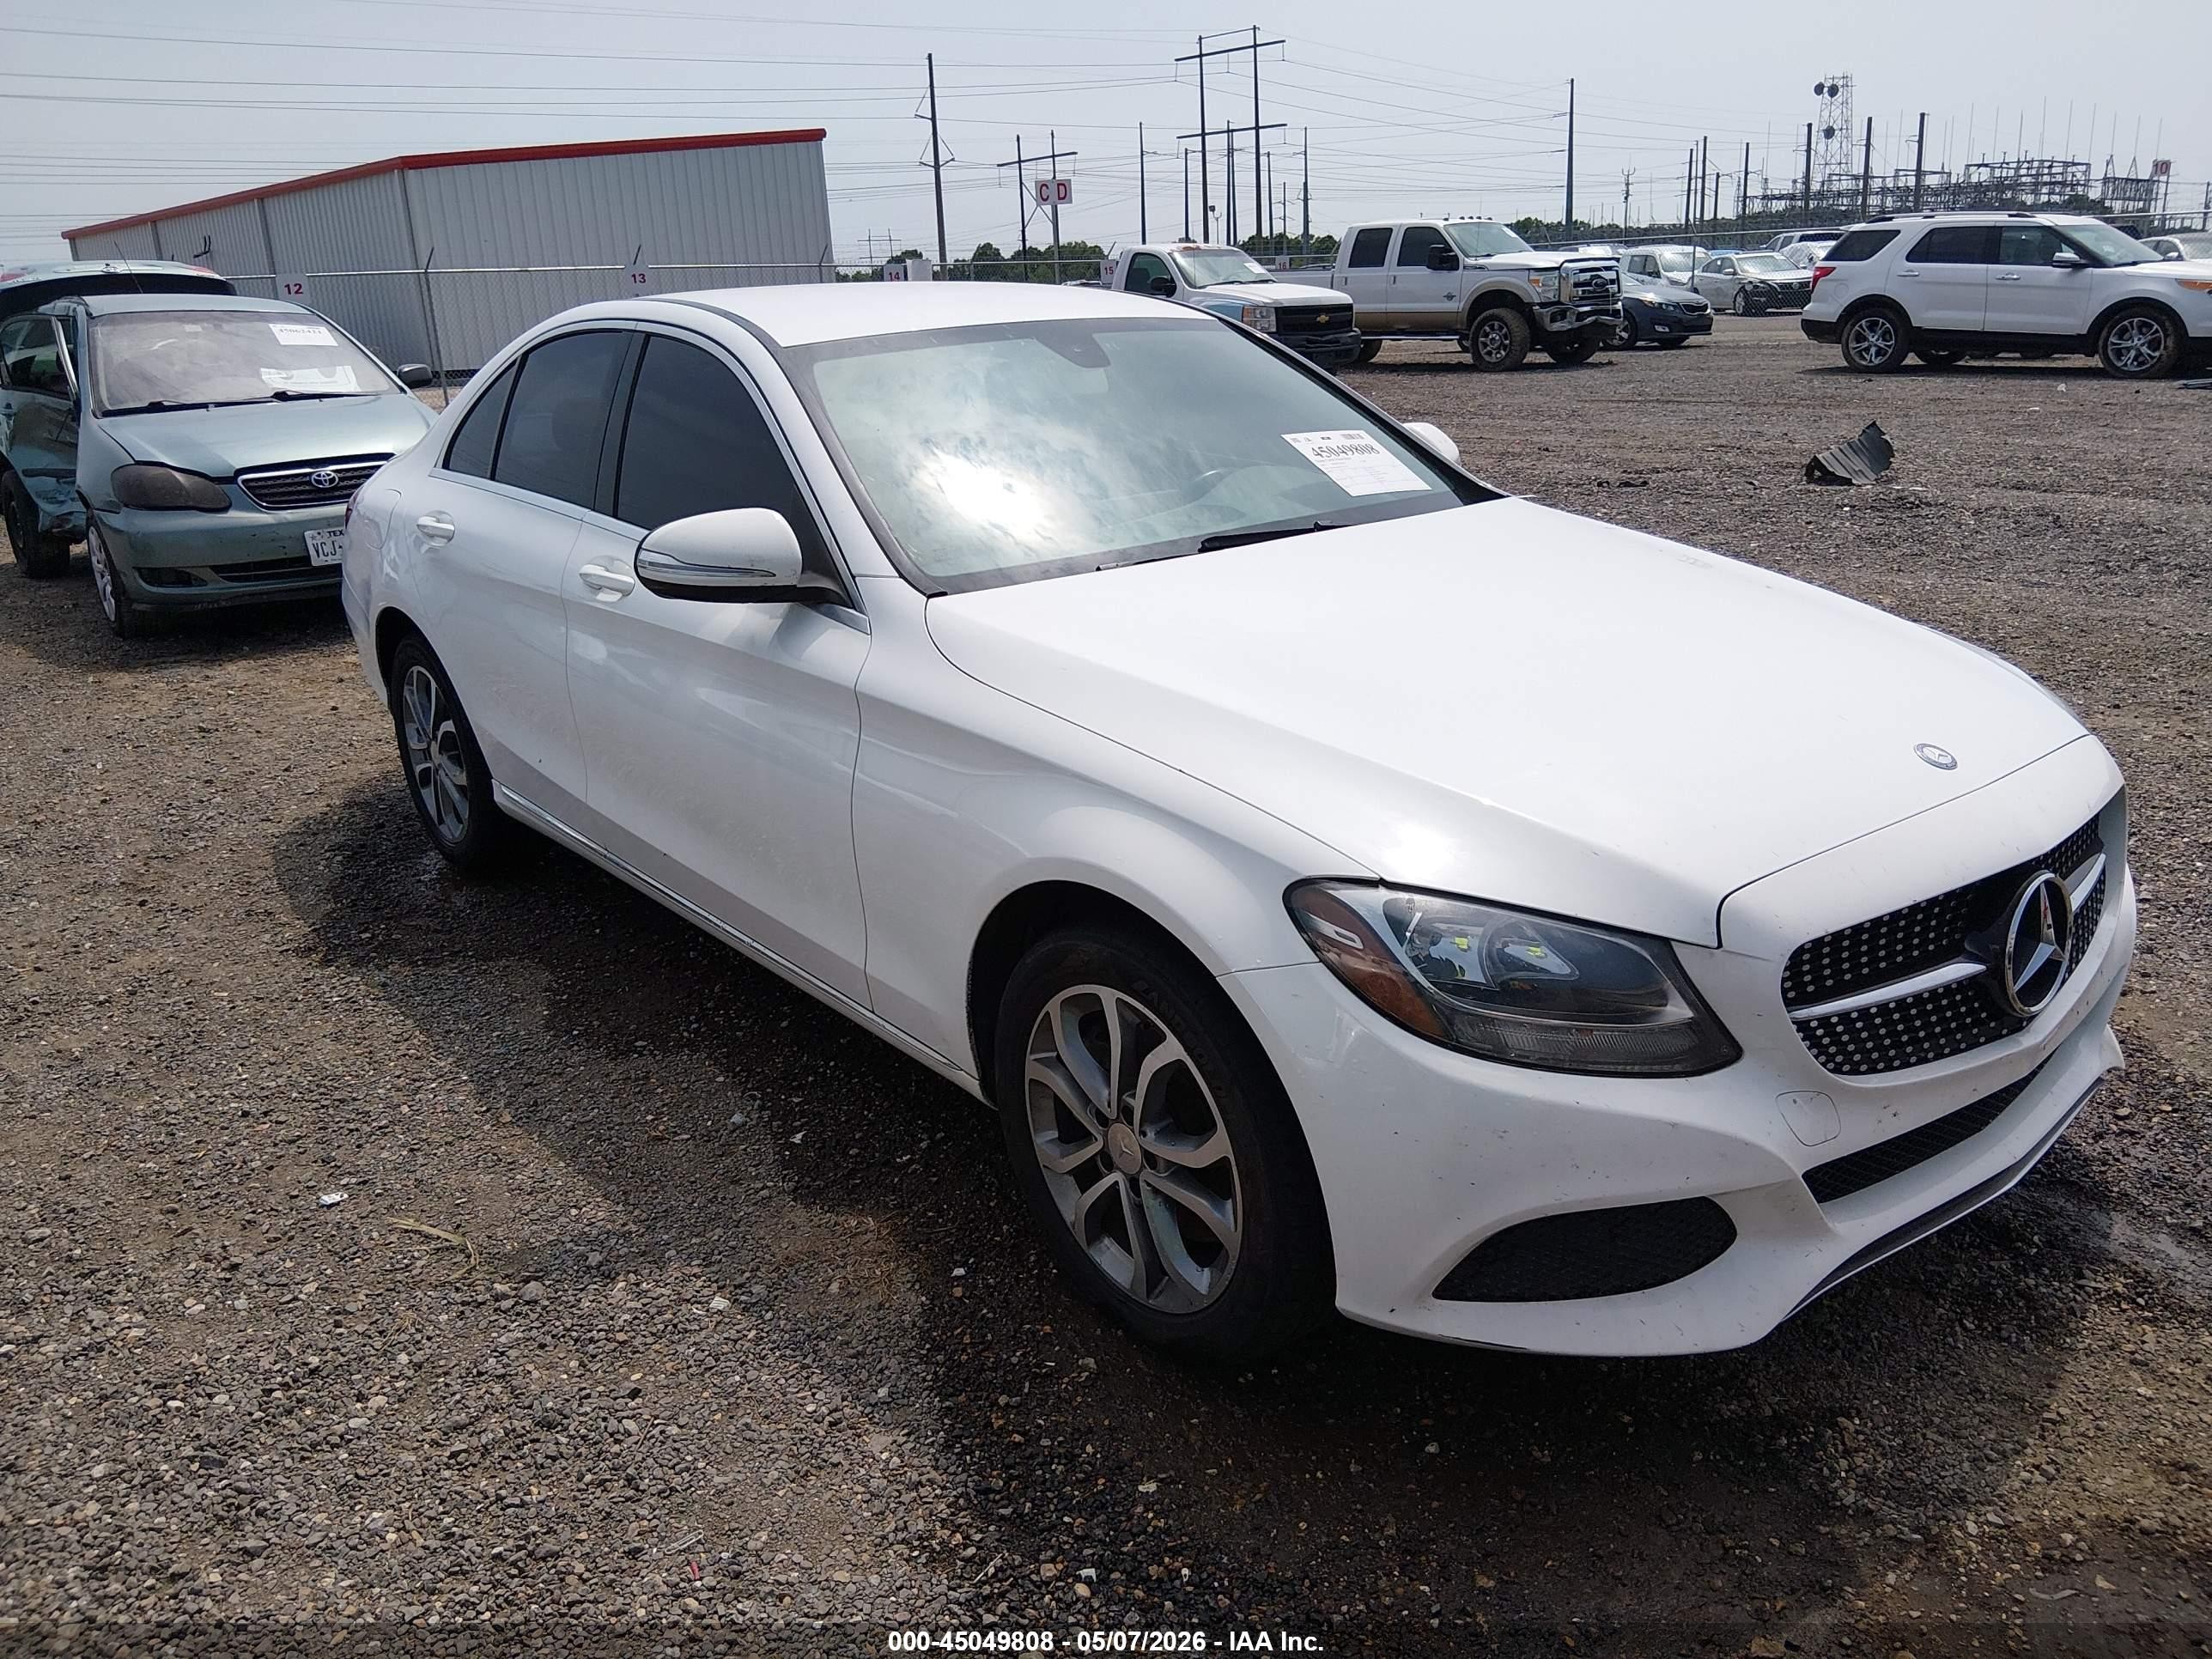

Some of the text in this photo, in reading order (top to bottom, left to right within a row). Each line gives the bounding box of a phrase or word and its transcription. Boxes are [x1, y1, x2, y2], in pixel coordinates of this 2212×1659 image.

[1039, 182, 1067, 202] C D
[888, 271, 900, 282] 14
[1104, 266, 1114, 276] 15
[631, 273, 647, 284] 13
[284, 283, 304, 295] 12
[1311, 443, 1381, 459] 45049808
[326, 529, 344, 538] TEX
